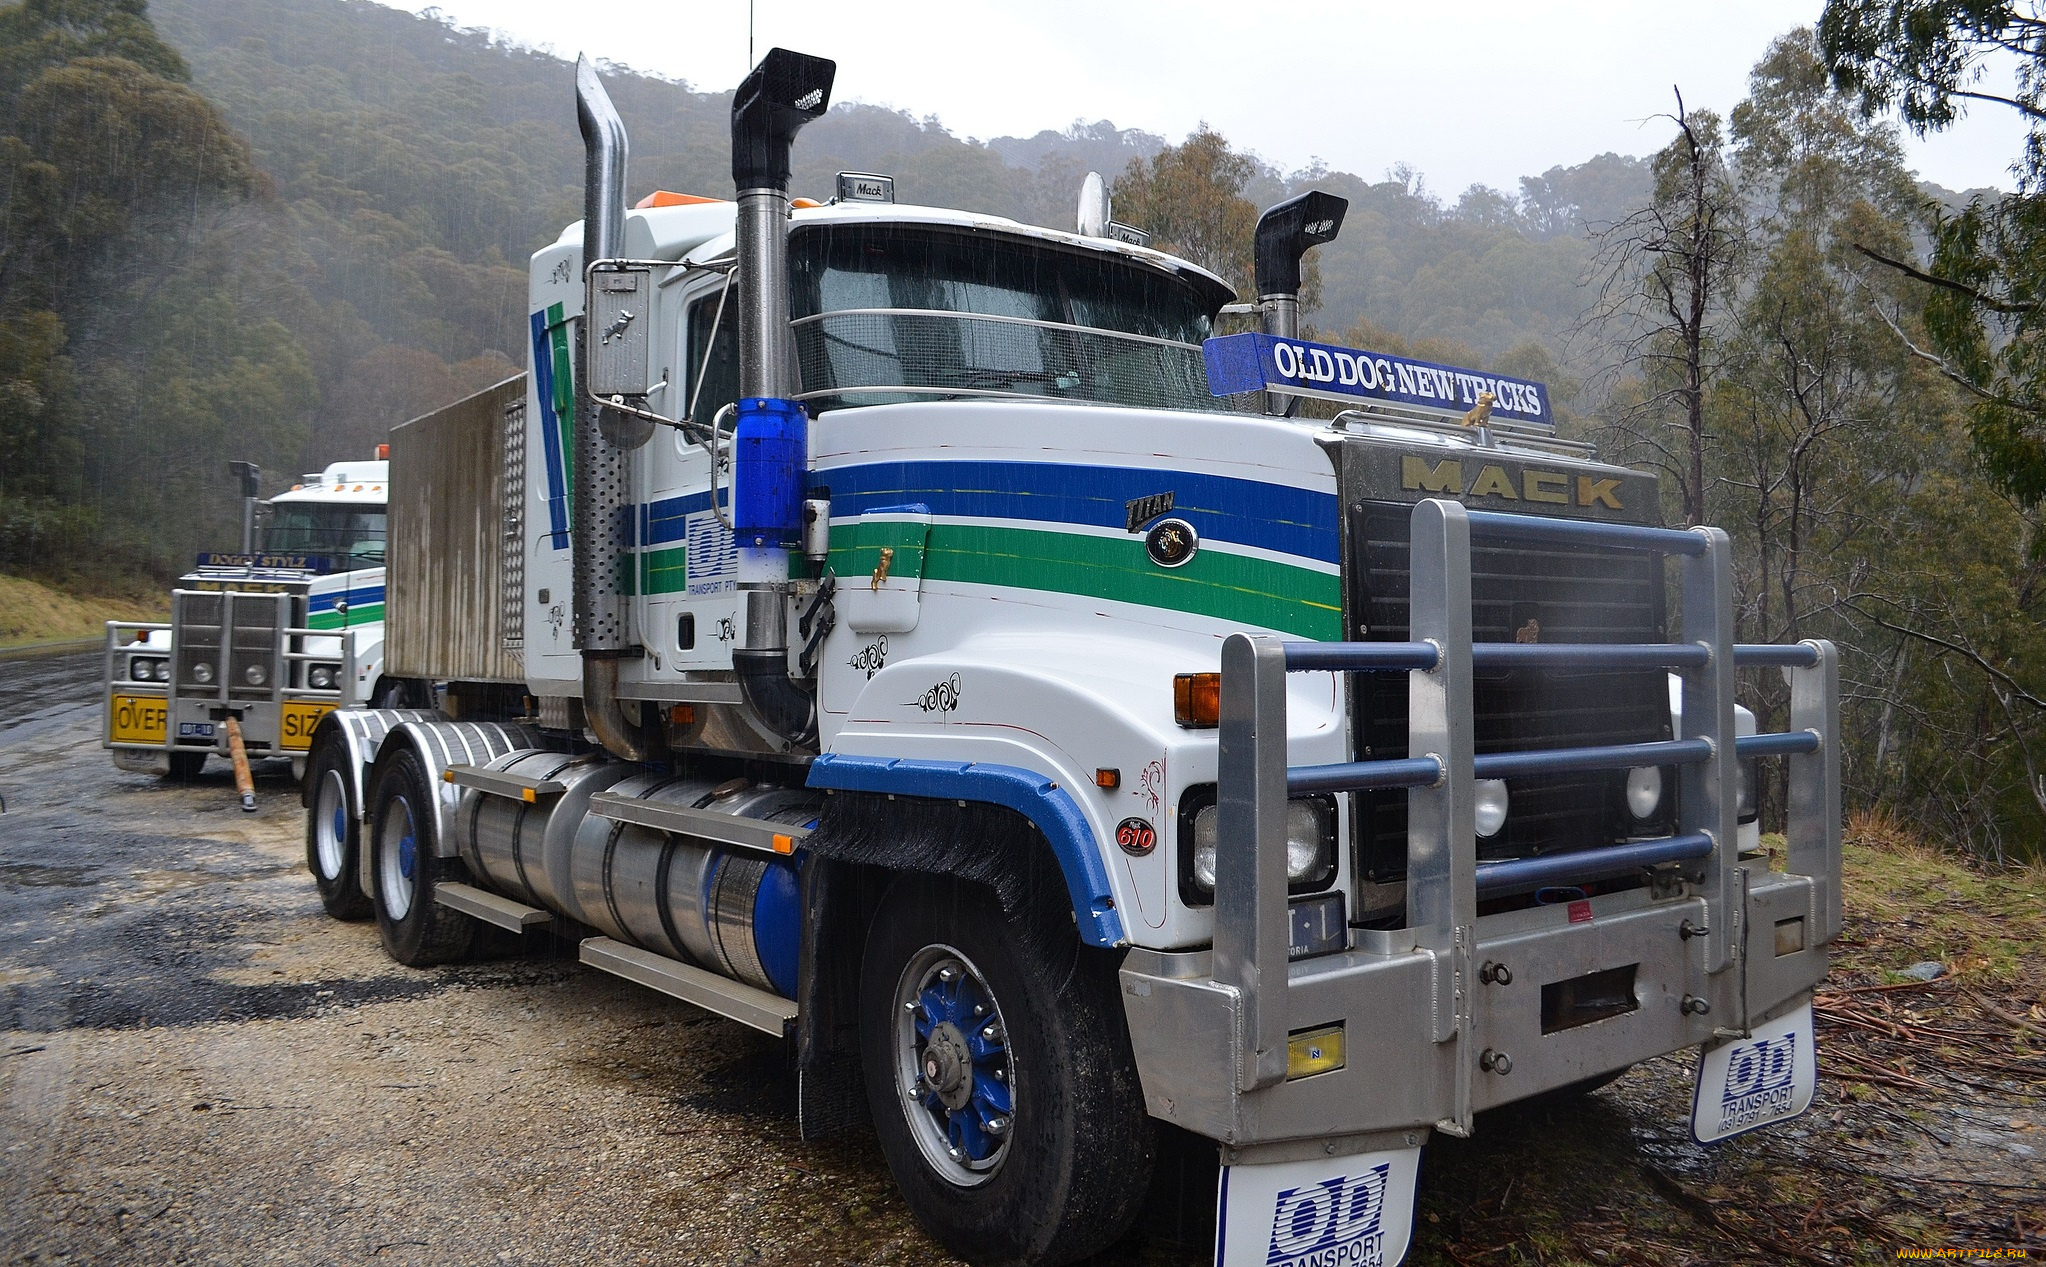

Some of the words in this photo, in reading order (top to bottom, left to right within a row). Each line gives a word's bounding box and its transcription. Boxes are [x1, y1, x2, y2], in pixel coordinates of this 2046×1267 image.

[856, 183, 882, 196] Mack
[1120, 233, 1141, 245] Mack
[1274, 342, 1335, 383] OLD
[1334, 352, 1396, 392] DOG
[1394, 362, 1456, 401] NEW
[1455, 373, 1541, 415] TRICKS
[1401, 455, 1624, 510] MACK
[1125, 490, 1175, 530] TITAN
[196, 581, 288, 593] MACK
[688, 582, 722, 596] TRANSPORT
[118, 706, 168, 730] OVER
[1117, 827, 1154, 848] 610
[1721, 1084, 1796, 1119] TRANSPORT
[1717, 1116, 1736, 1134] (03)
